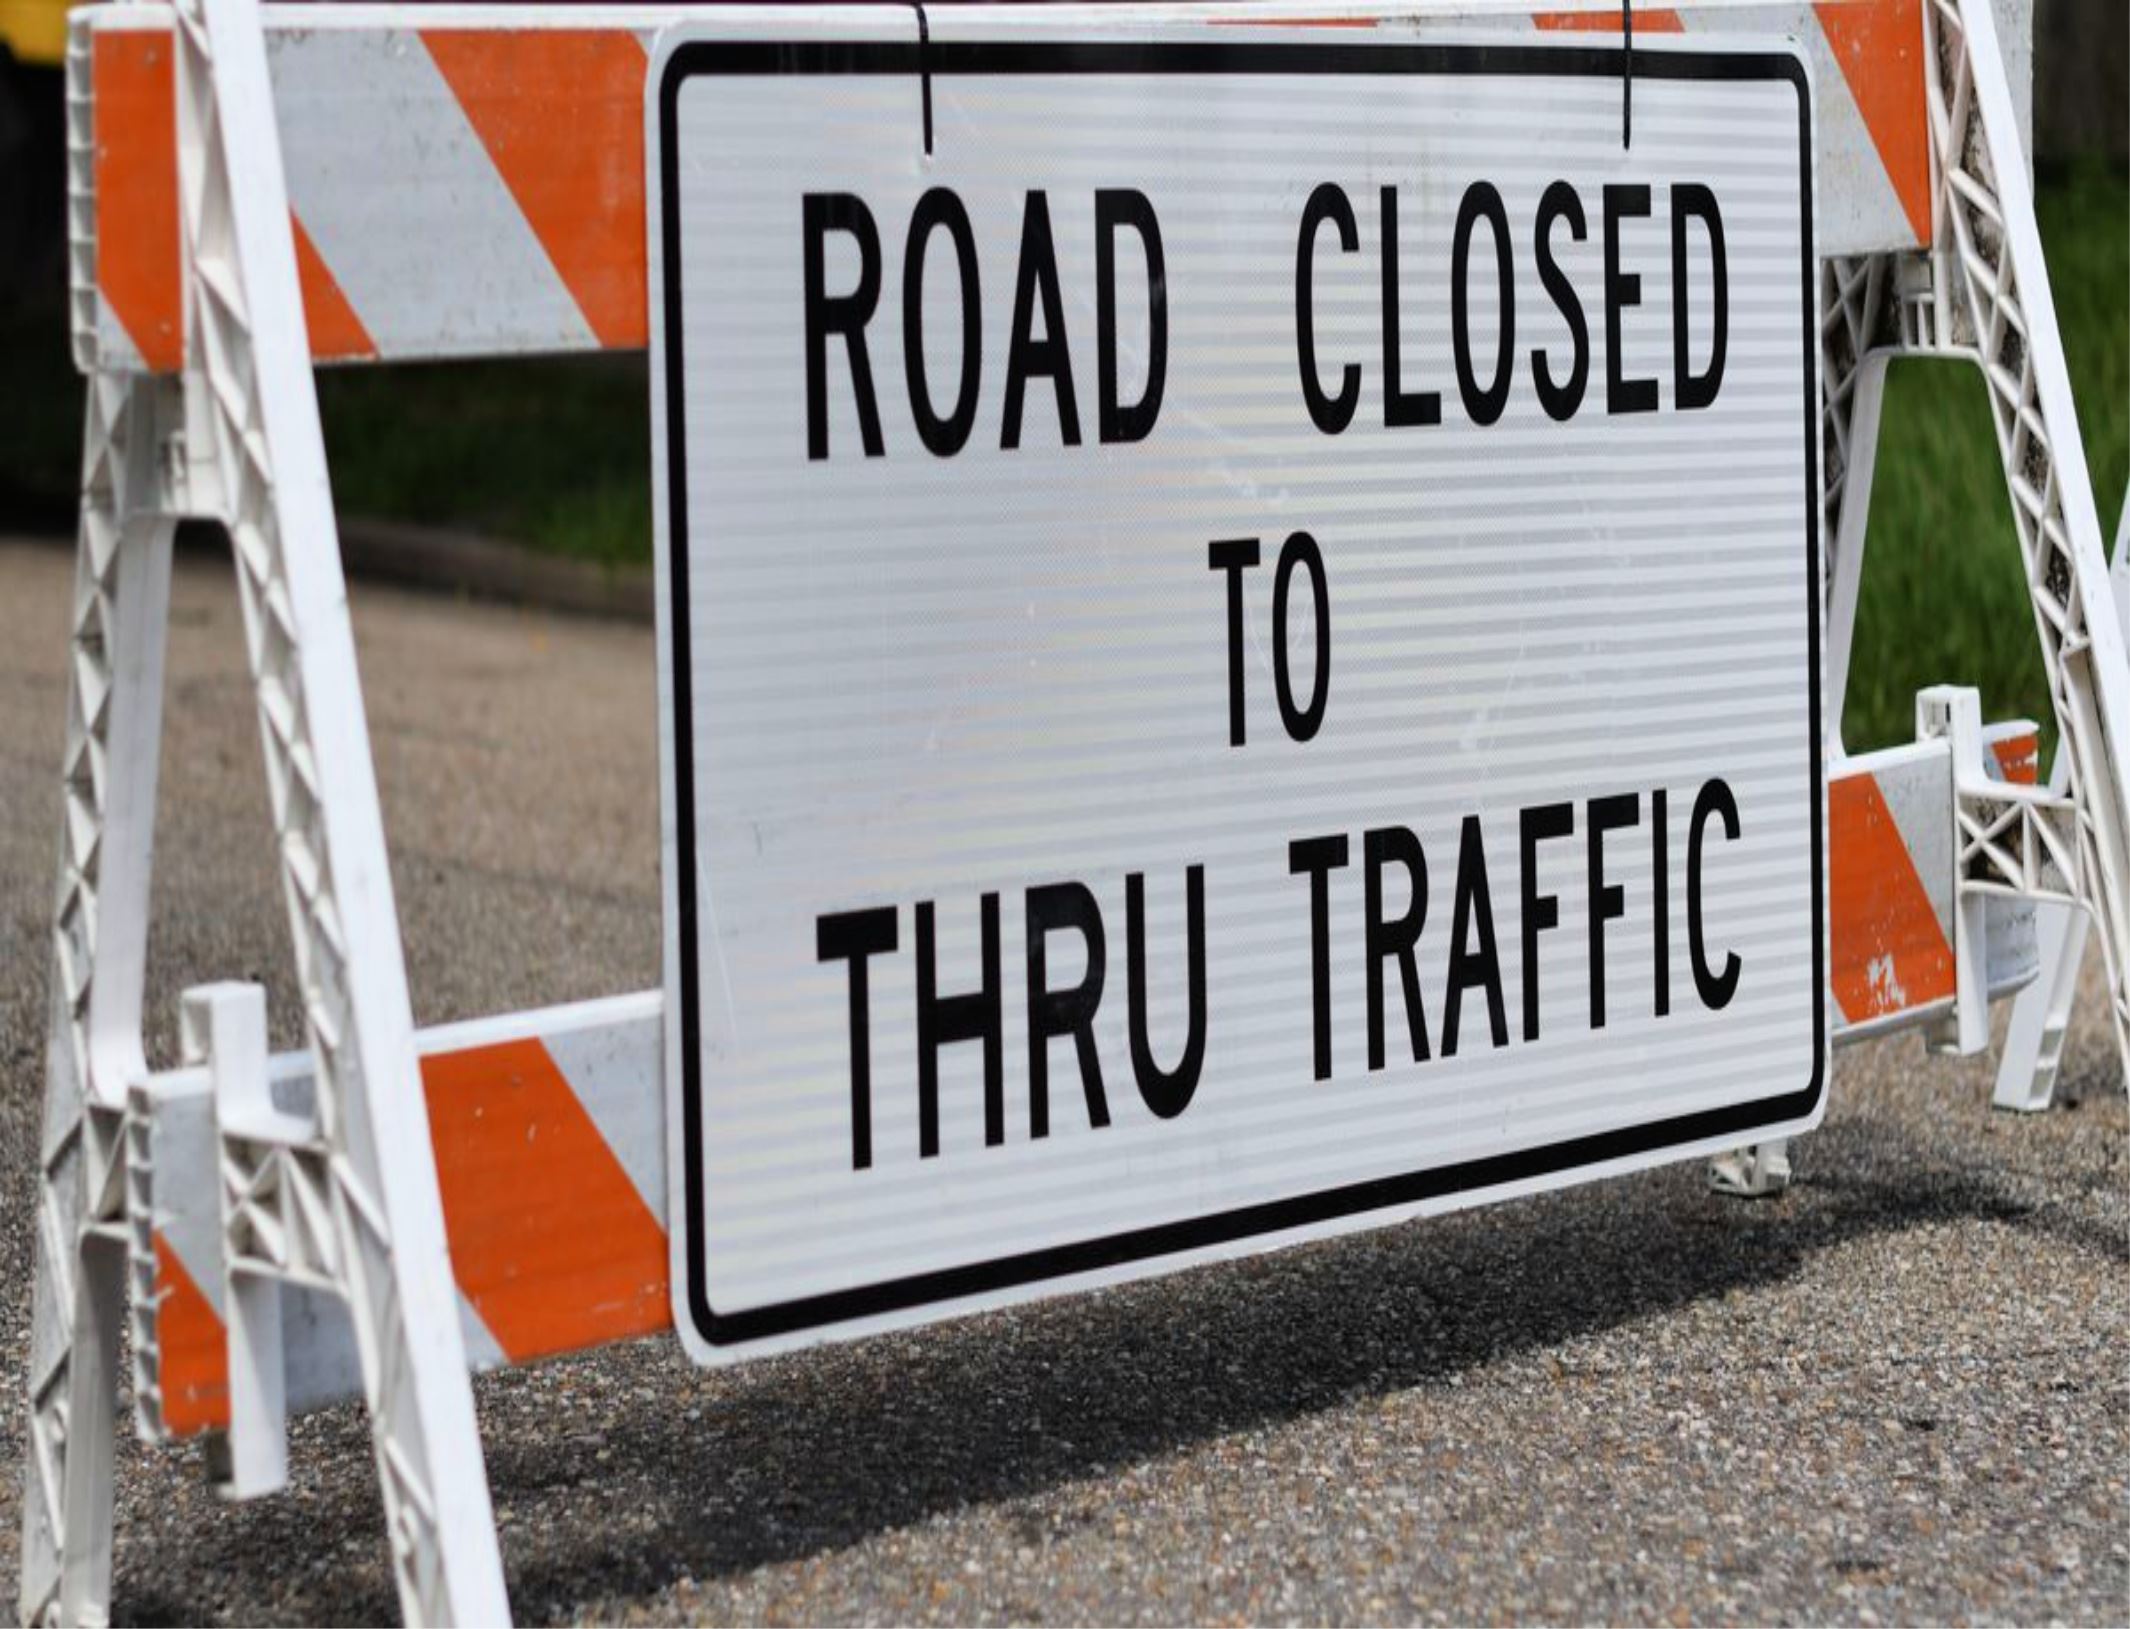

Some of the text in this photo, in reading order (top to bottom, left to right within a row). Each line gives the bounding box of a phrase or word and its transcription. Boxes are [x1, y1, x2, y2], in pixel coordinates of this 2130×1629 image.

[802, 180, 1729, 461] ROAD CLOSED
[1208, 531, 1331, 747] TO
[816, 778, 1742, 1170] THRU TRAFFIC
